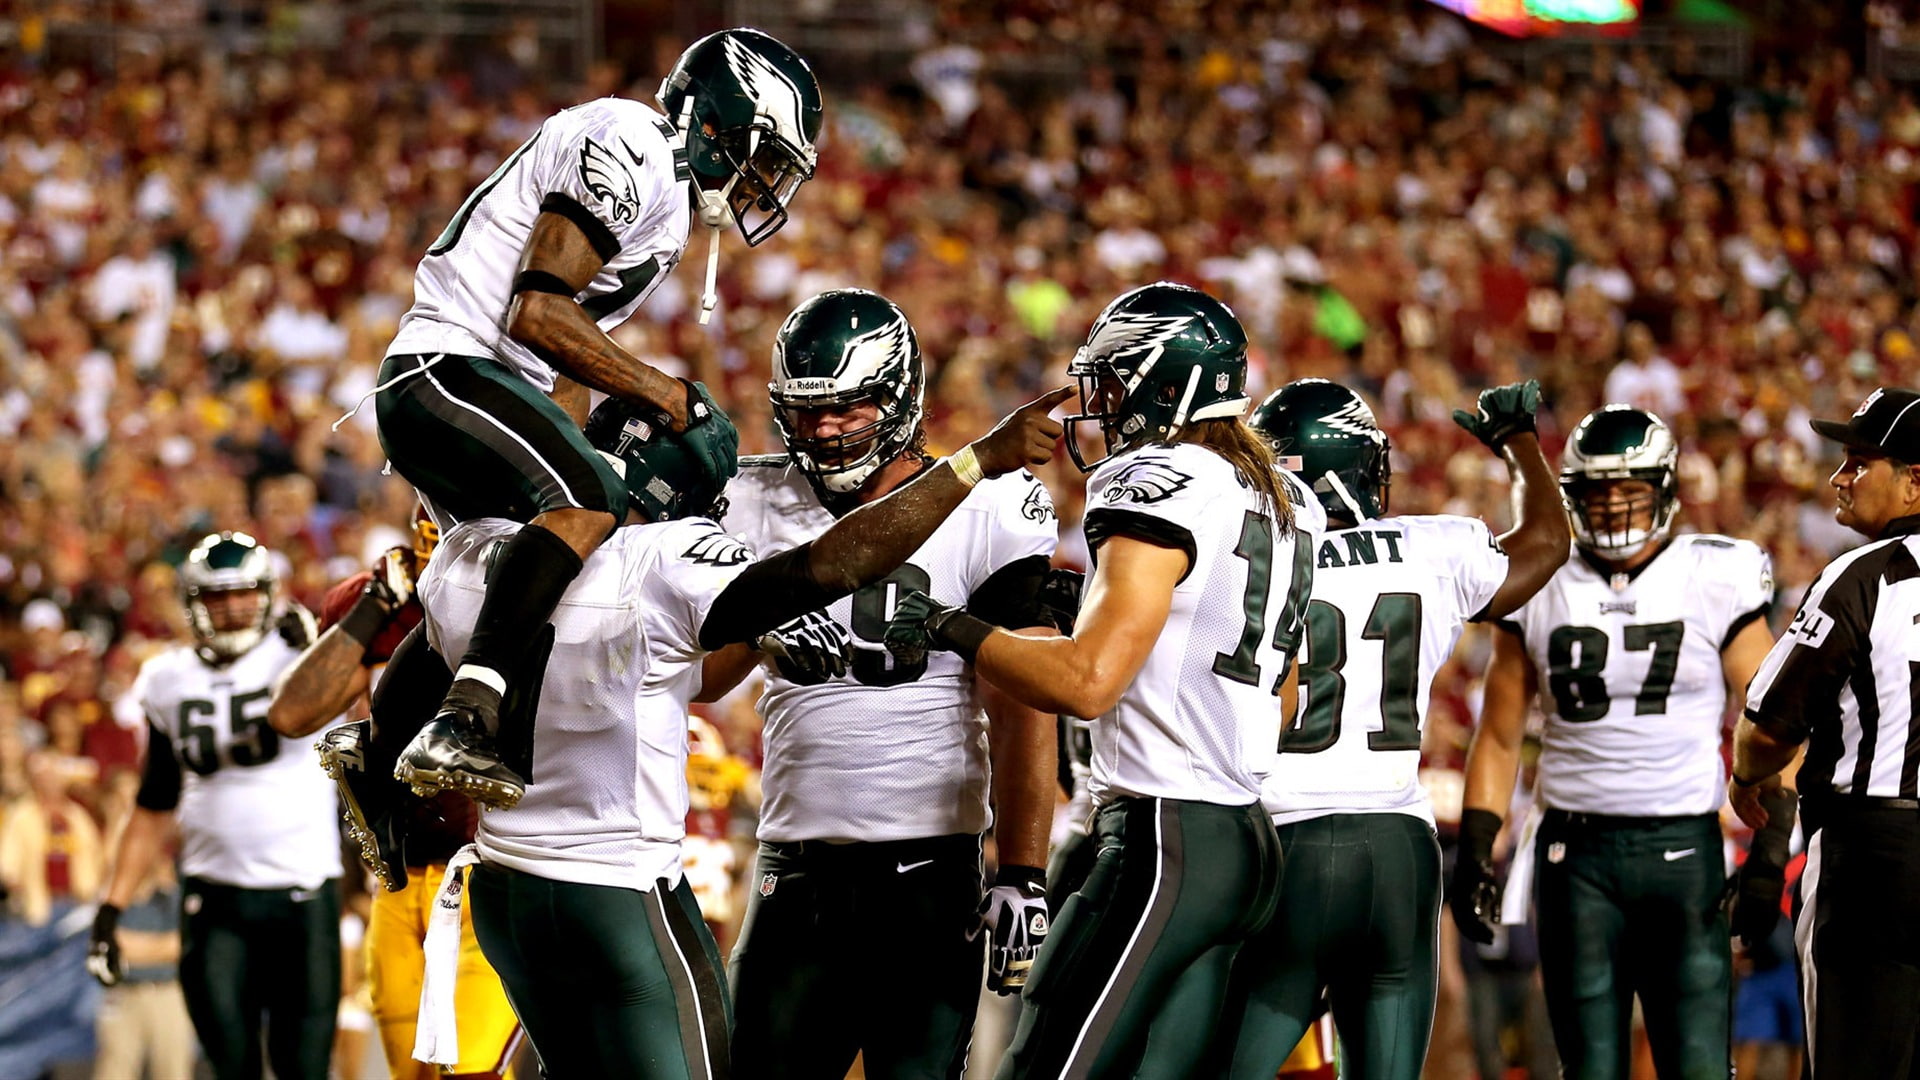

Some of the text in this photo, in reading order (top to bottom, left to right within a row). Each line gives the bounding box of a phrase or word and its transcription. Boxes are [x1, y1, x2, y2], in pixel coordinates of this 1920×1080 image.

[797, 380, 825, 390] Riddell
[615, 431, 634, 456] 7
[1212, 509, 1313, 696] 14
[1548, 620, 1685, 723] 87
[179, 688, 280, 776] 65
